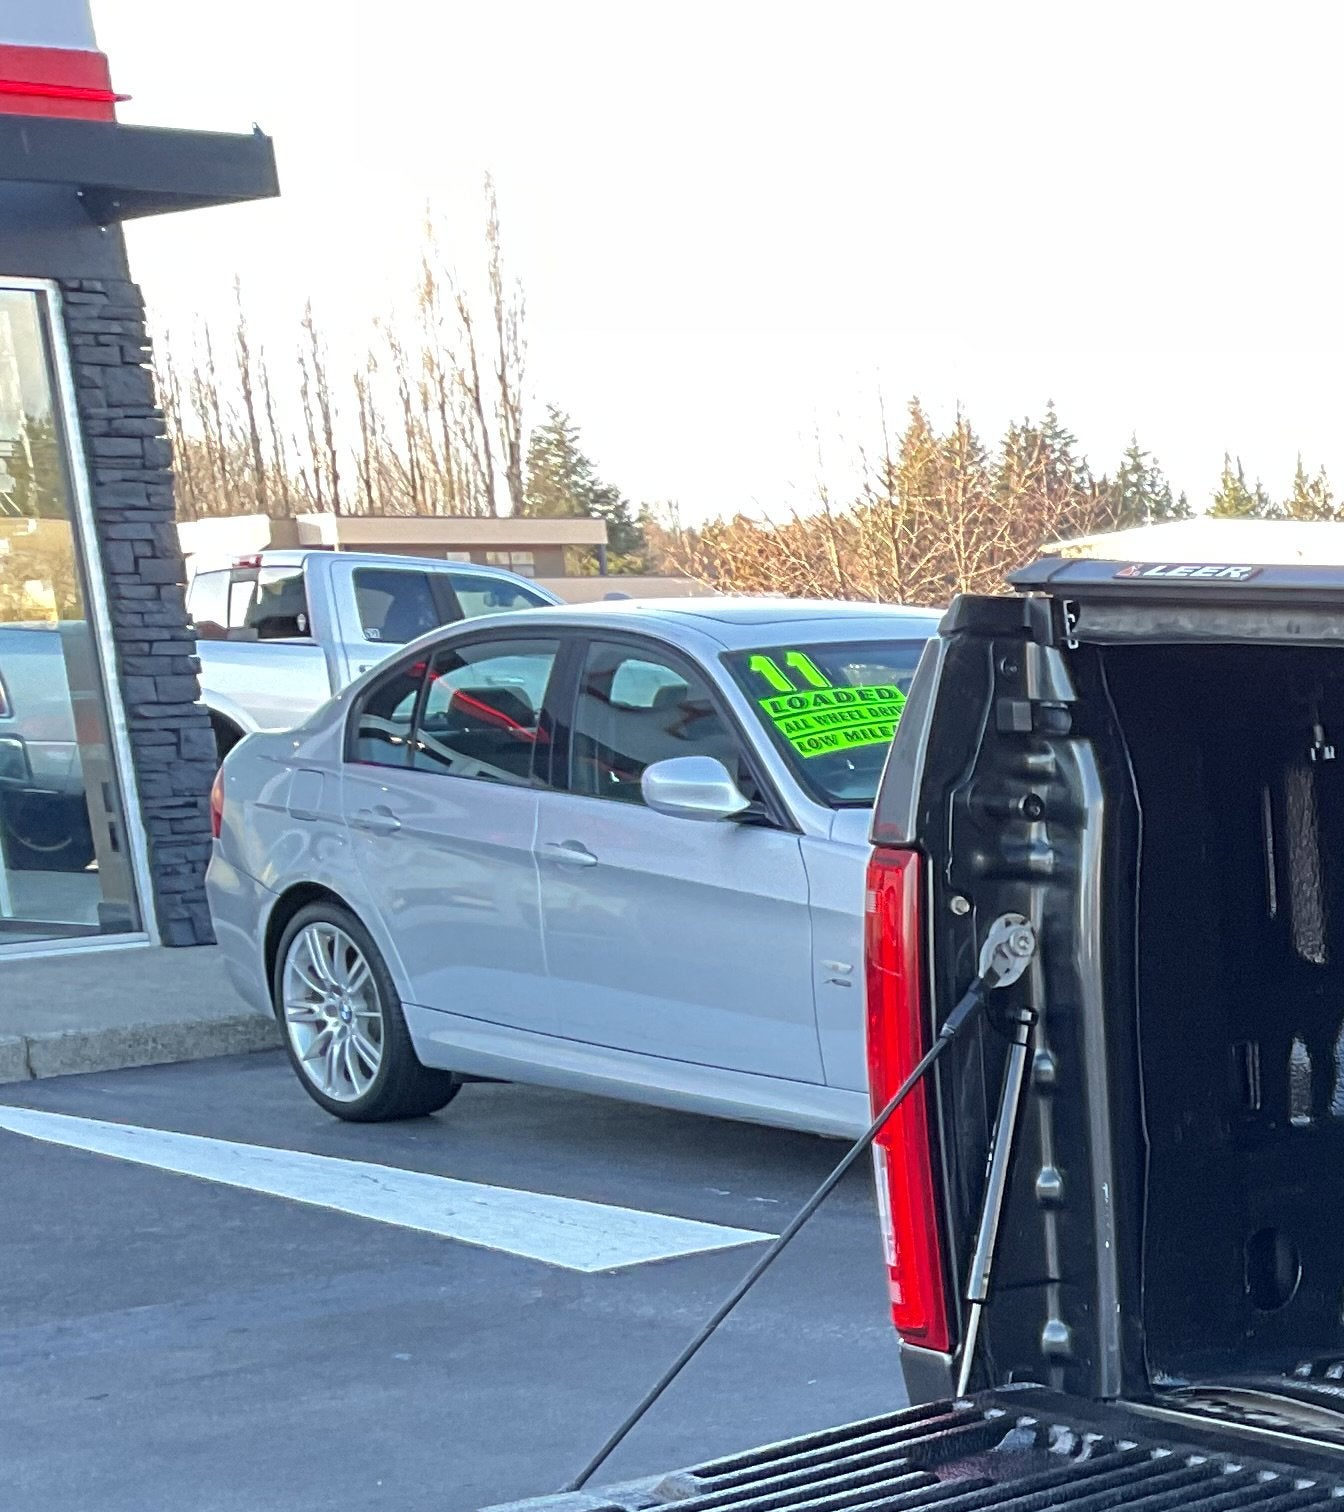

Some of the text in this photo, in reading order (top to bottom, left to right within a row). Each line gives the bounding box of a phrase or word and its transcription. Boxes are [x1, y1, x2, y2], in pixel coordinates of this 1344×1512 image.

[1143, 565, 1253, 578] LEER
[750, 651, 832, 692] 11
[768, 686, 899, 714] LOADED
[784, 703, 905, 734] ALL WHEEL DRIV
[795, 734, 838, 753] LOW
